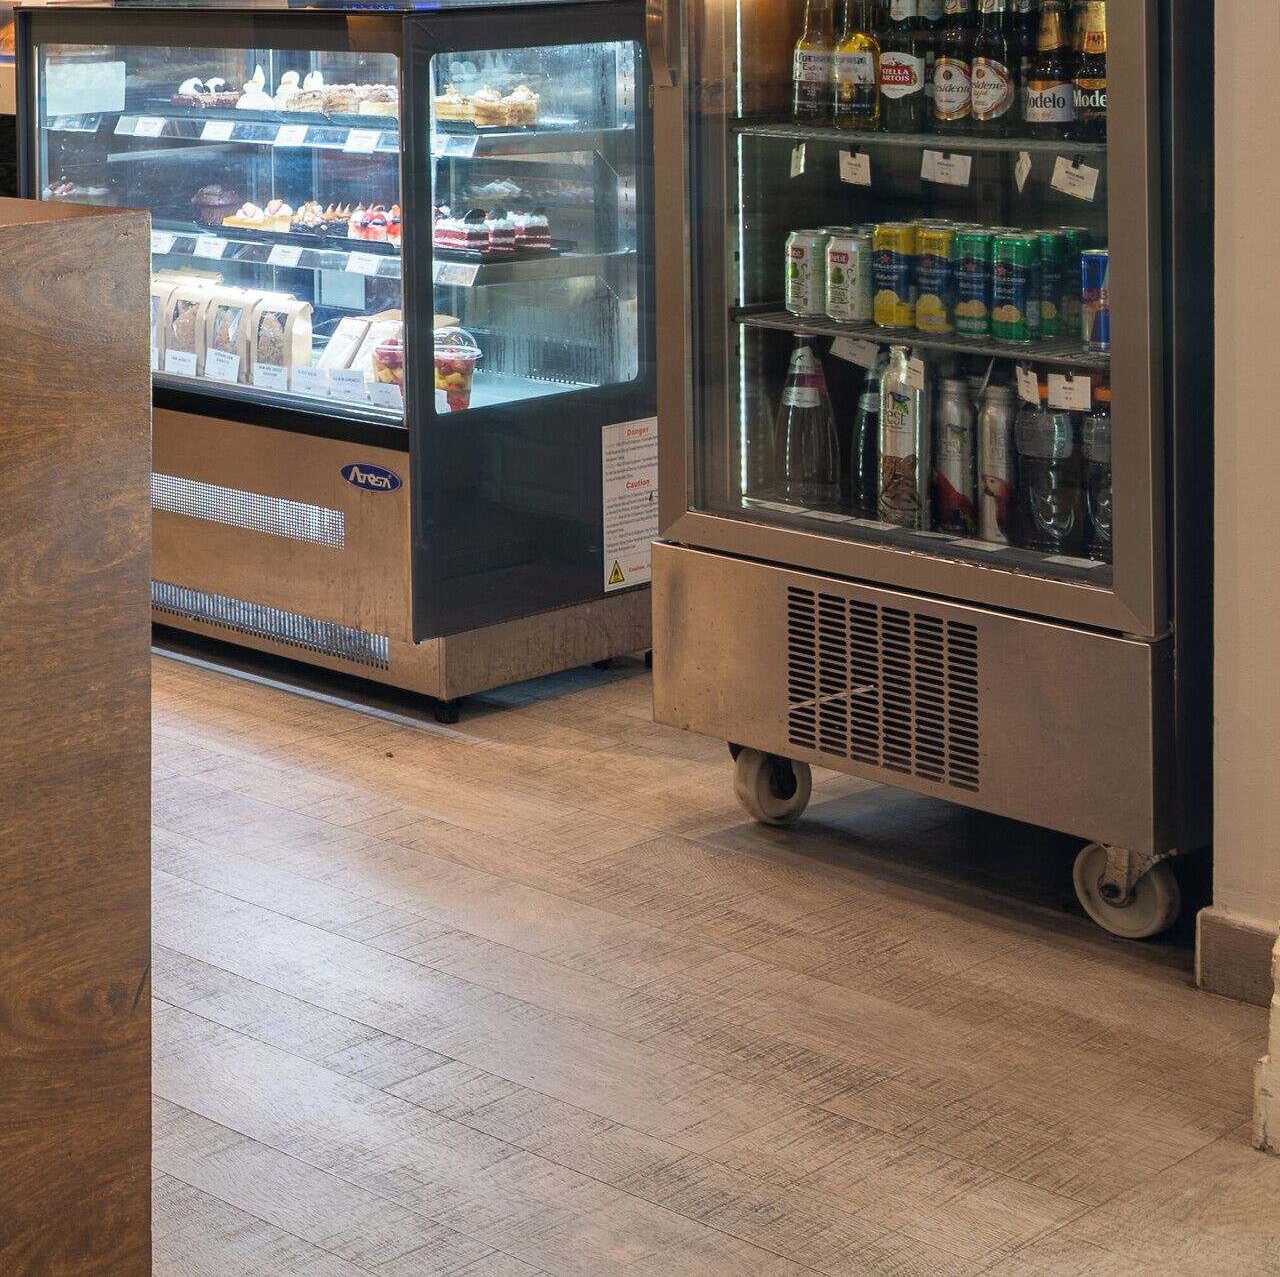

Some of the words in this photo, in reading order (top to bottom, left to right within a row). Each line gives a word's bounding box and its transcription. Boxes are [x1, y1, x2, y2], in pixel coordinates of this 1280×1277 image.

[881, 67, 910, 76] STELLA
[881, 74, 911, 83] ARTOIS
[936, 82, 971, 94] esidente
[972, 80, 1007, 91] sidente
[1073, 89, 1107, 108] Mode
[626, 427, 649, 436] Danger
[625, 479, 650, 489] Caution
